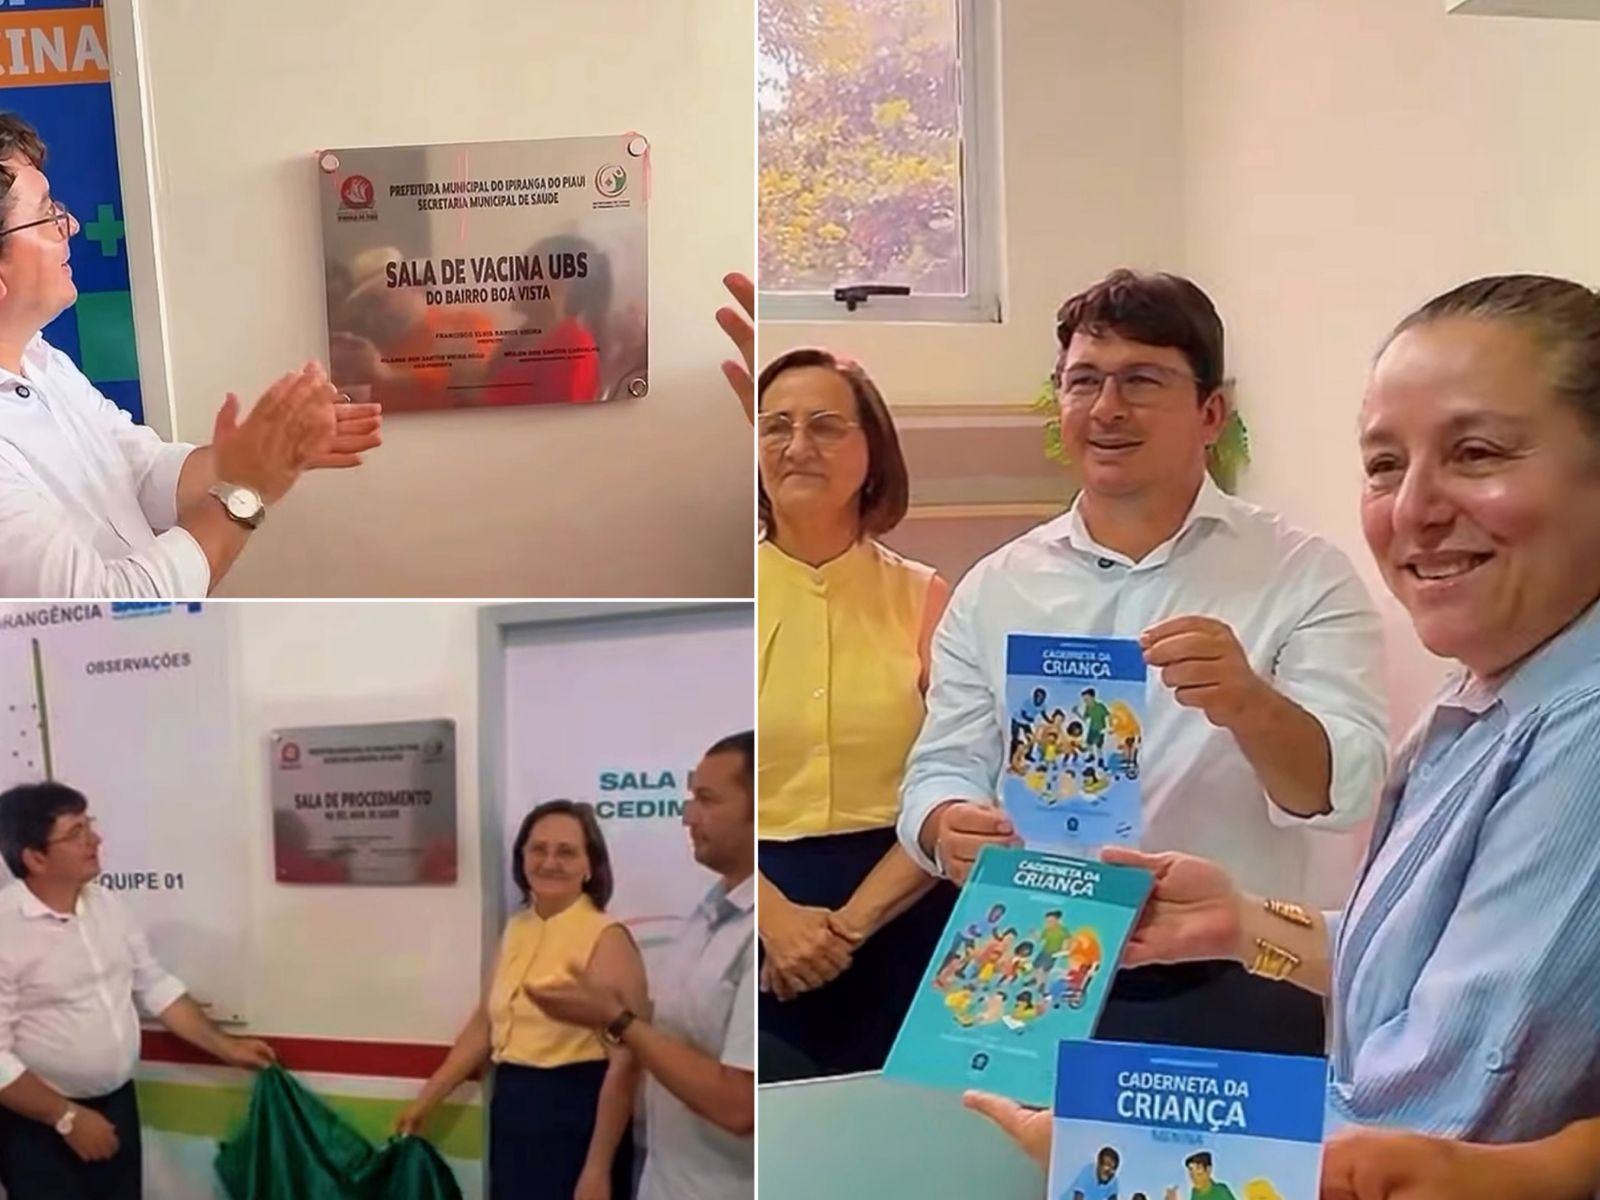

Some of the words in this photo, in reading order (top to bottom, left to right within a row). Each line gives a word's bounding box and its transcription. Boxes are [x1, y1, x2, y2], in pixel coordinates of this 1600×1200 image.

[0, 25, 109, 75] INA
[389, 183, 440, 197] PREFEITURA
[442, 180, 490, 194] MUNICIPAL
[491, 180, 504, 191] DO
[505, 177, 547, 191] IPIRANGA
[548, 177, 561, 188] DO
[417, 197, 468, 211] SECRETARIA
[470, 195, 516, 208] MUNICIPAL
[518, 193, 530, 205] DE
[386, 259, 436, 288] SALA
[442, 257, 466, 285] DE
[470, 254, 544, 283] VACINA
[549, 252, 588, 279] UBS
[426, 290, 443, 305] DO
[446, 287, 488, 304] BAIRRO
[491, 286, 515, 301] BOA
[518, 284, 551, 300] VISTA
[0, 604, 102, 629] RANGÊNCIA
[86, 653, 192, 675] OBSERVAÇÕES
[1043, 660, 1112, 680] CRIANÇA
[600, 771, 676, 790] SALA
[294, 793, 322, 809] SALA
[324, 792, 338, 808] DE
[340, 790, 432, 807] PROCEDIMENTO
[595, 799, 686, 819] CEDIM
[99, 873, 159, 891] QUIPE
[164, 873, 184, 889] 01
[1013, 871, 1094, 897] CRIANÇA
[1083, 871, 1100, 882] DA
[1118, 1072, 1219, 1096] CADERNETA
[1224, 1079, 1249, 1098] DA
[1116, 1090, 1247, 1132] CRIANÇA
